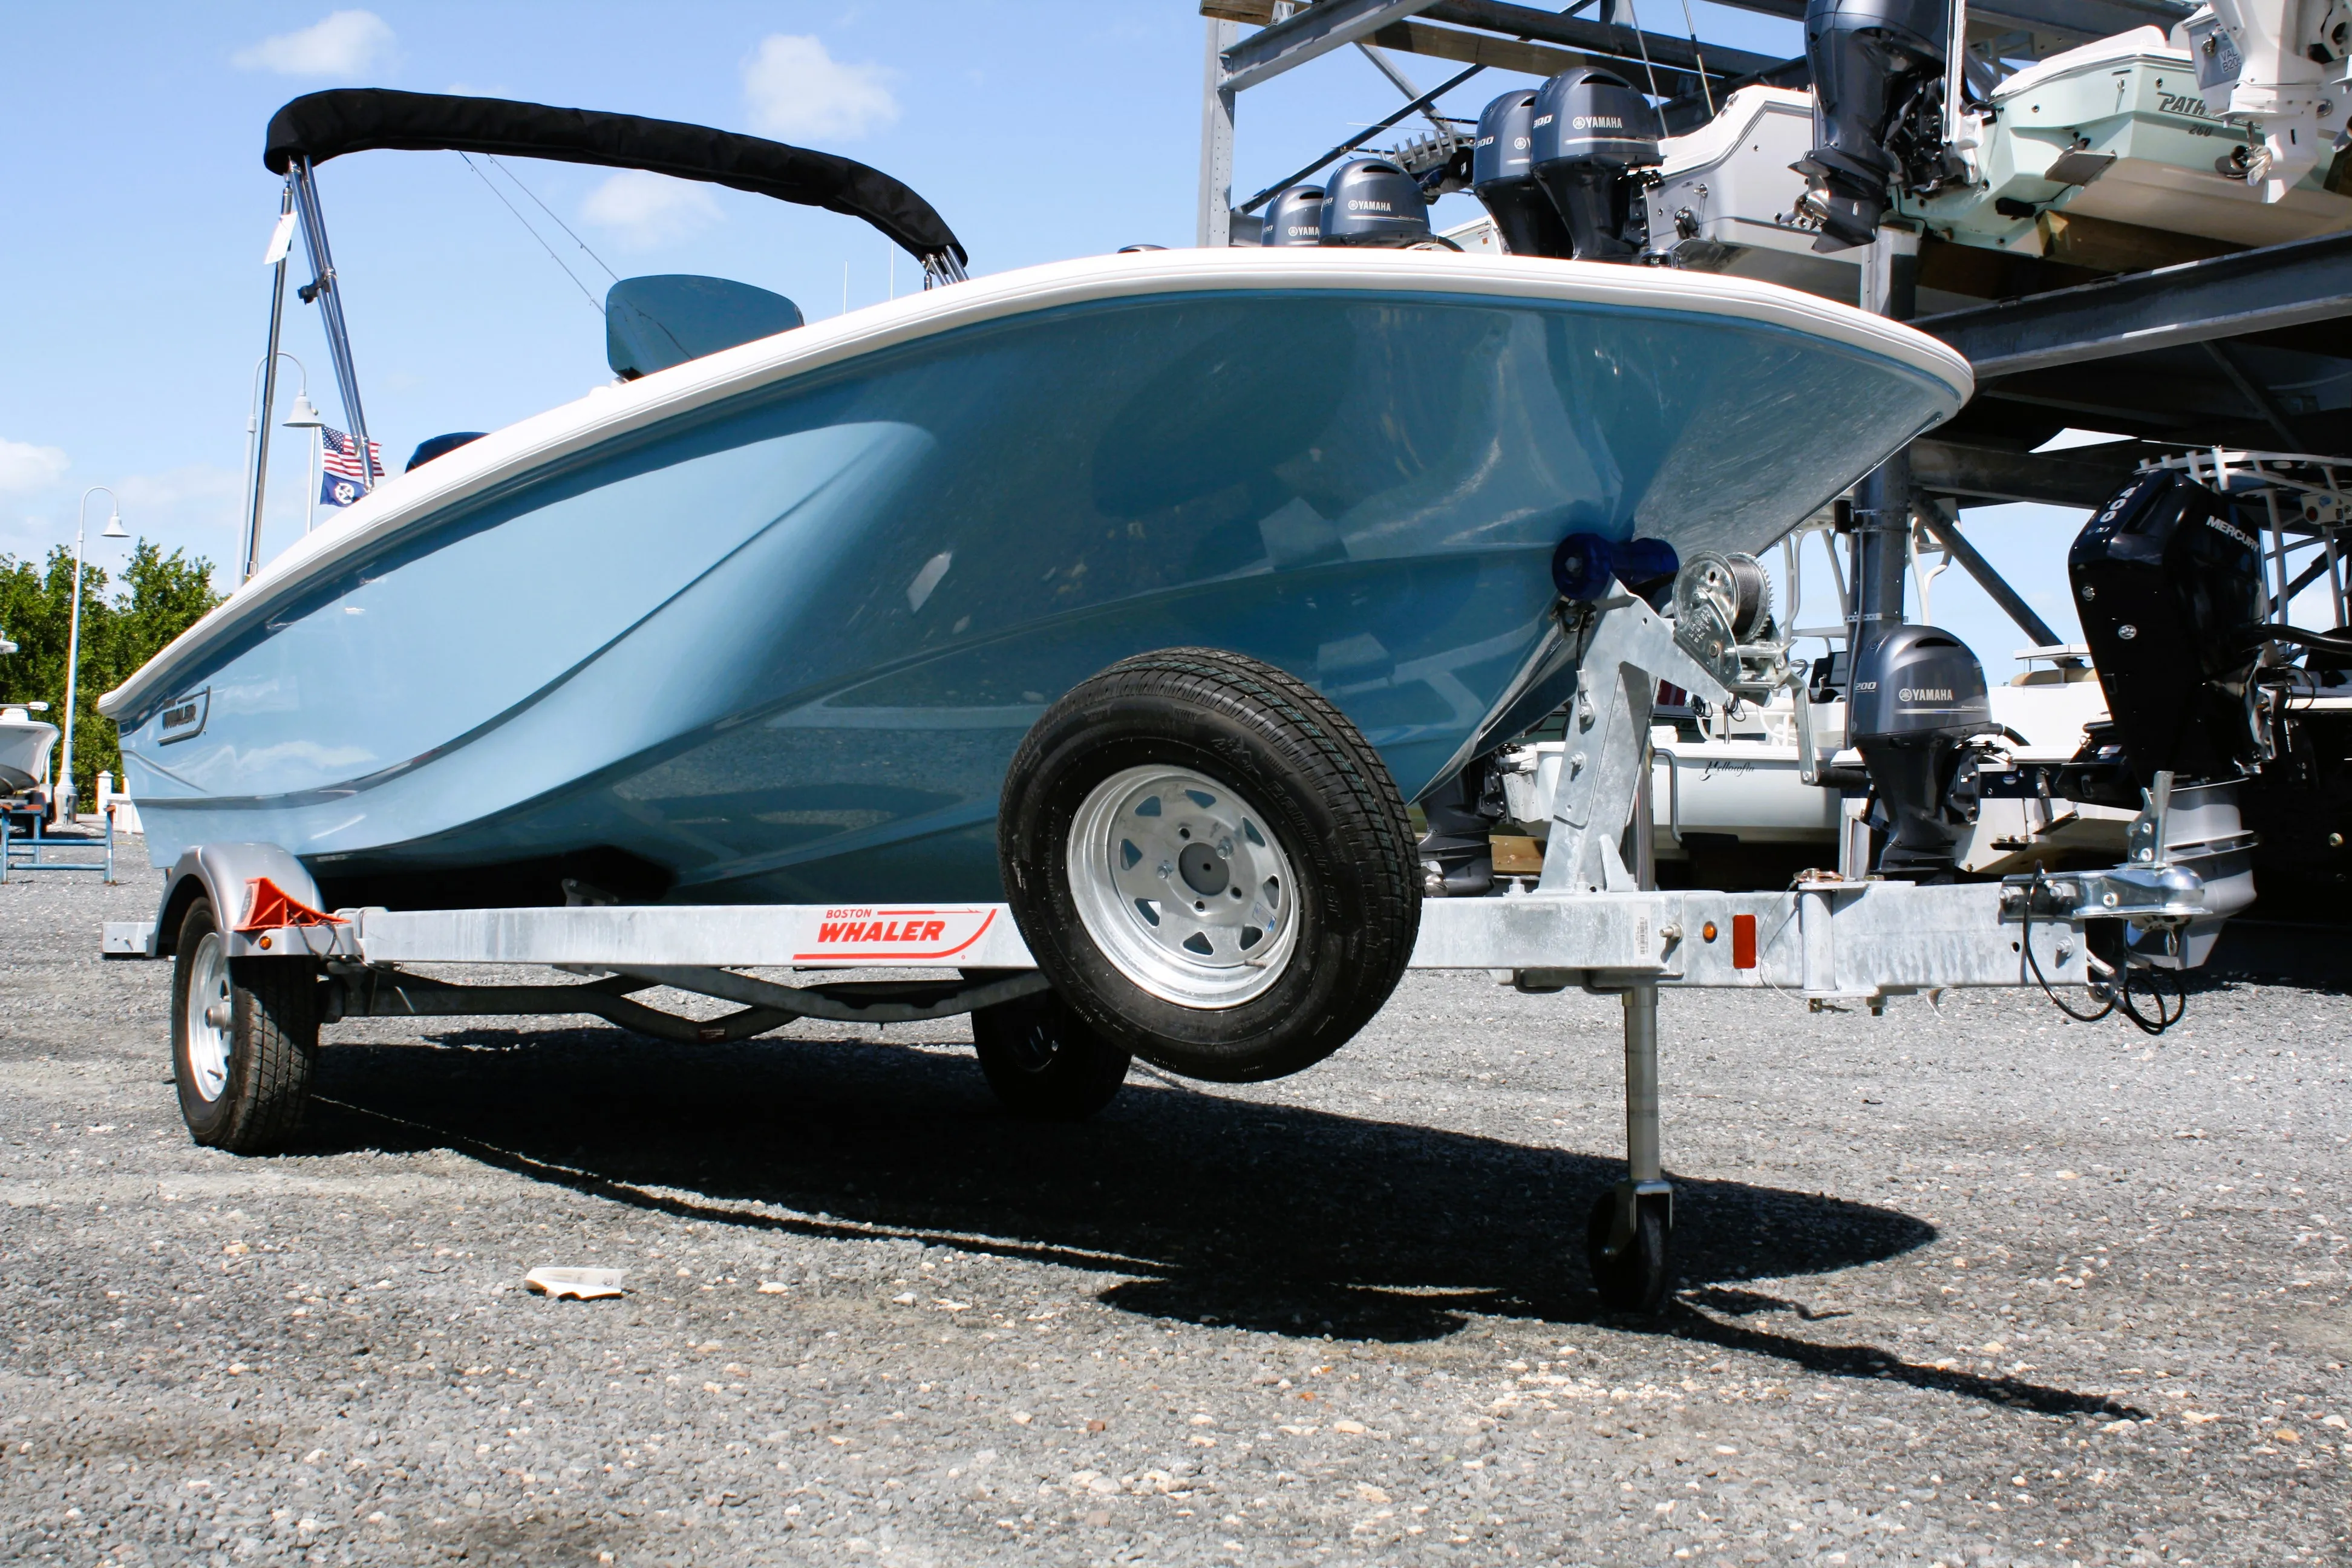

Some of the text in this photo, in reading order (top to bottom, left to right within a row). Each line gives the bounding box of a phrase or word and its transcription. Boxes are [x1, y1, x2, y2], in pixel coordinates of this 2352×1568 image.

[1533, 114, 1553, 129] 300
[1586, 116, 1623, 128] YAMAHA
[2188, 123, 2214, 137] 260
[1476, 136, 1494, 148] 300
[1358, 201, 1391, 212] YAMAHA
[1298, 226, 1319, 236] YAMA
[2099, 486, 2137, 523] 400
[2206, 515, 2260, 552] MERCURY
[1855, 681, 1877, 691] 200
[1912, 688, 1953, 701] YAMAHA
[1699, 760, 1756, 782] Yellowfin
[825, 909, 872, 919] BOSTON
[817, 920, 946, 942] WHALER
